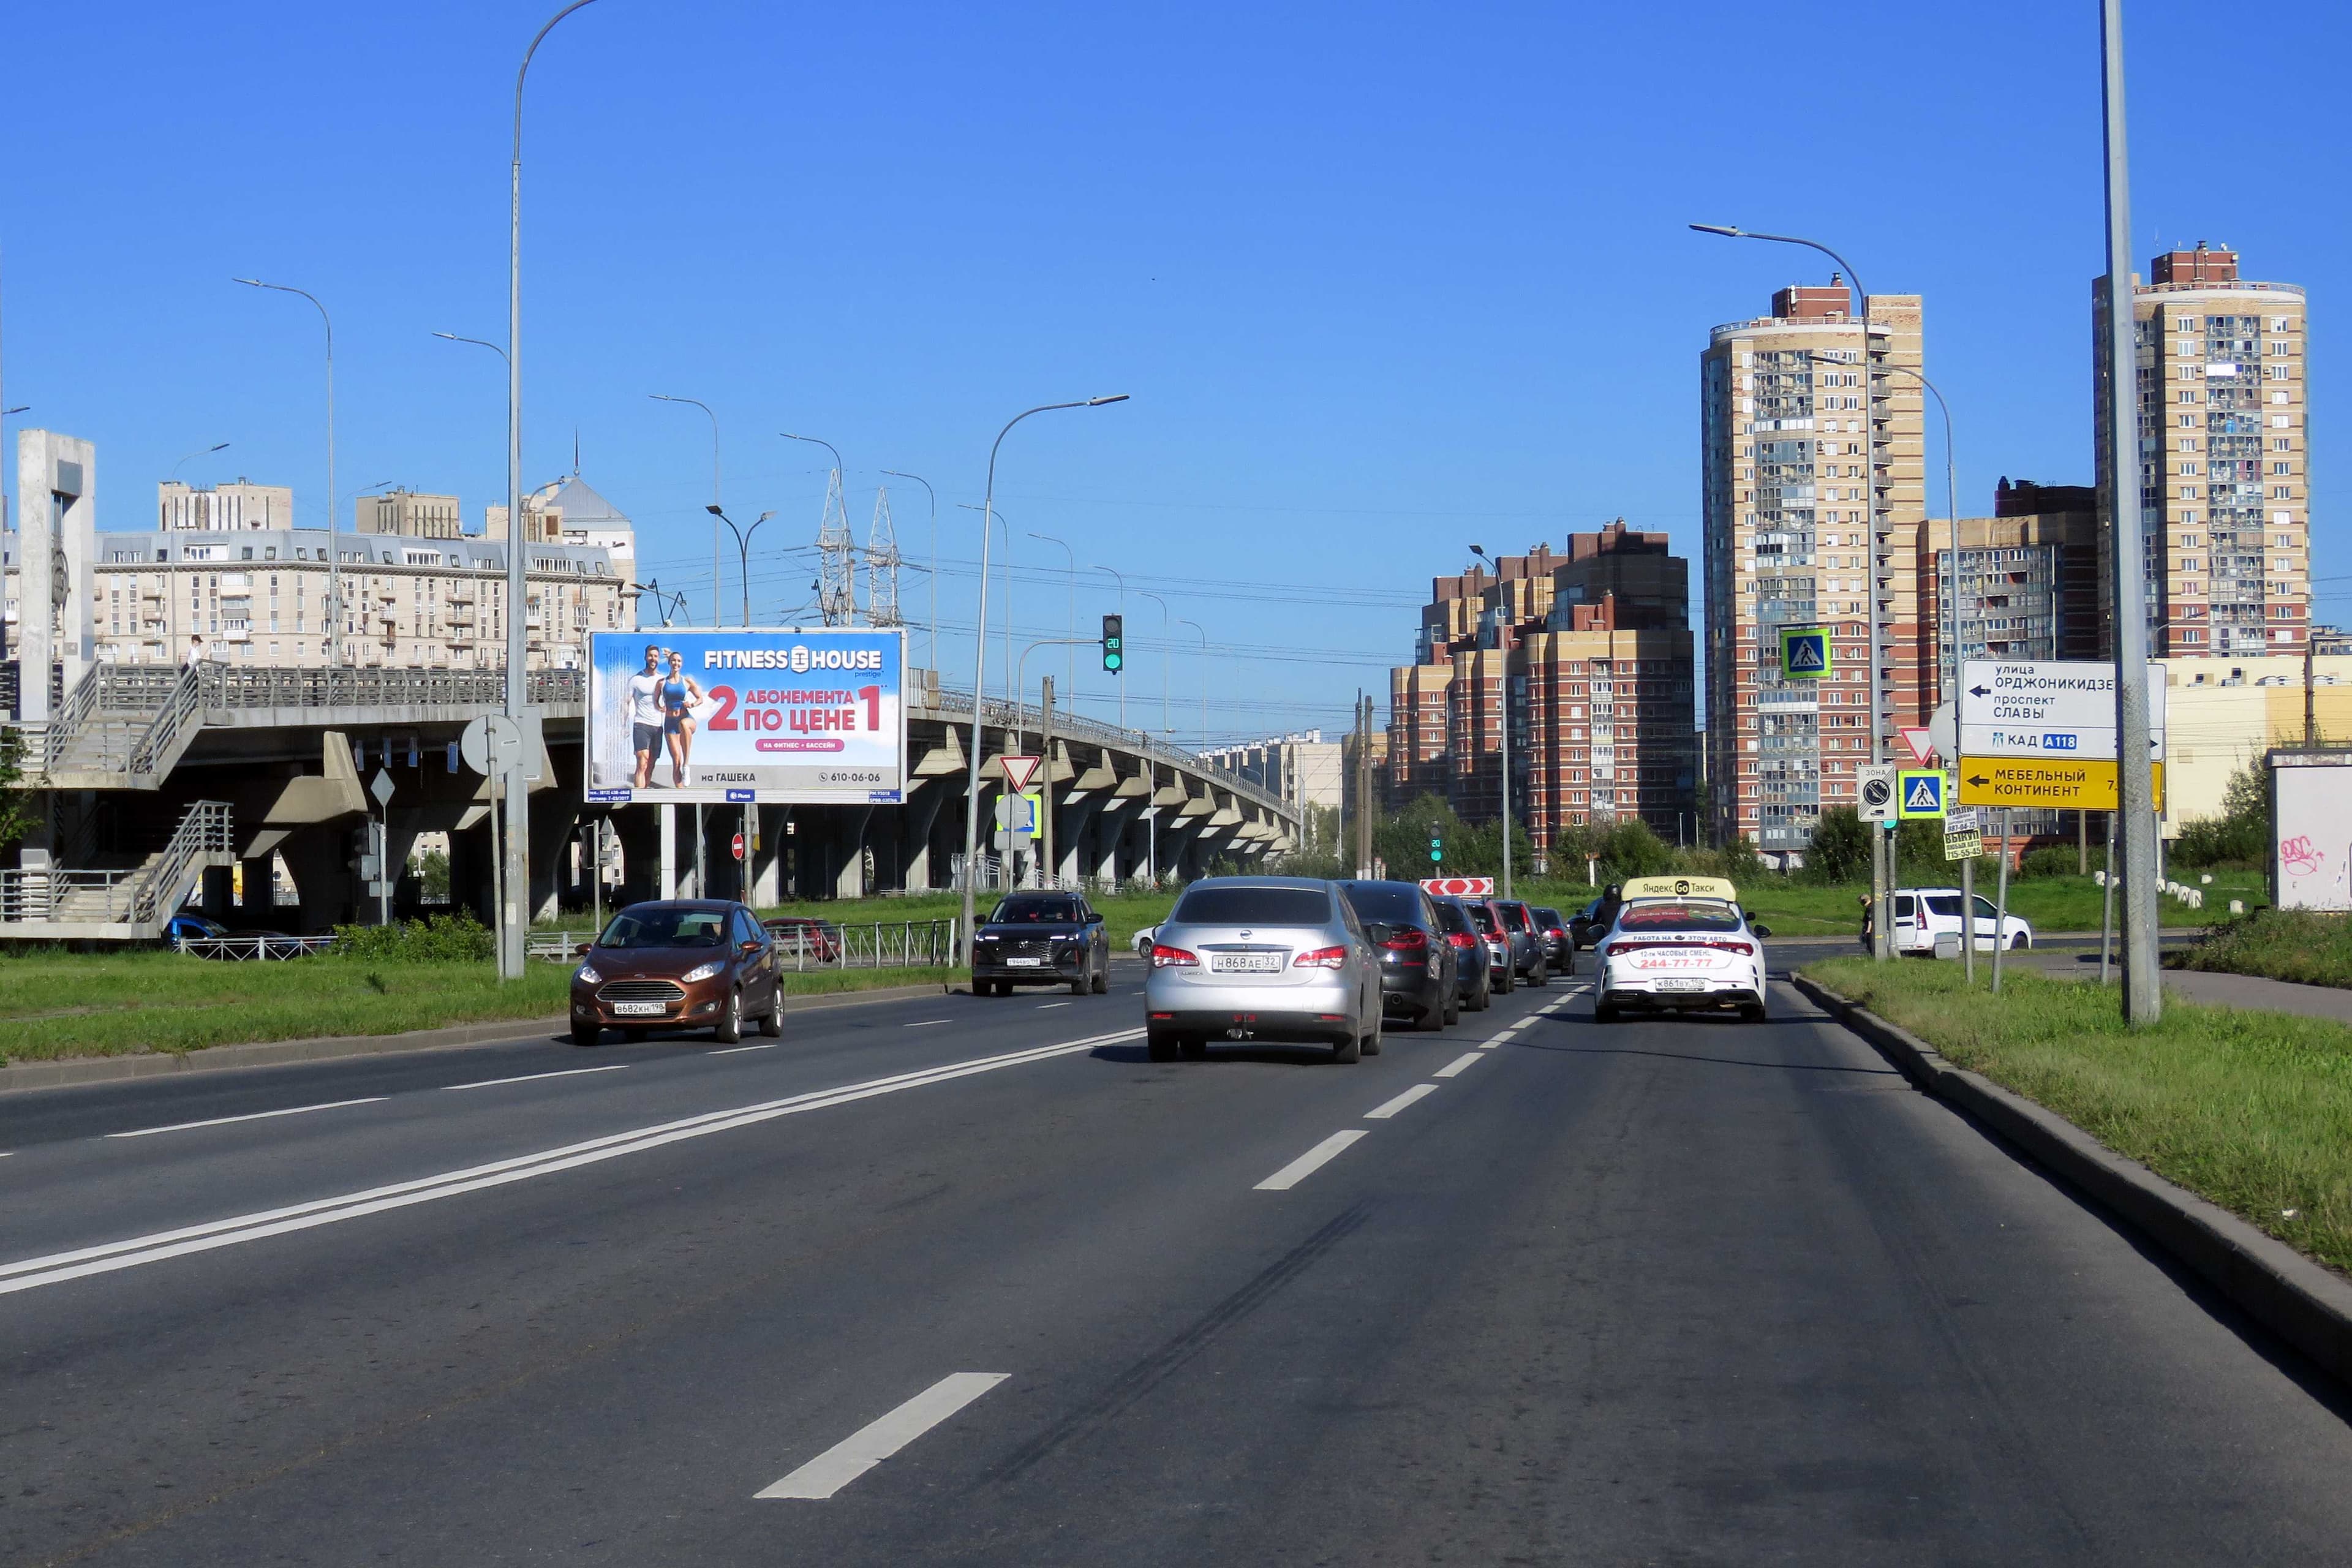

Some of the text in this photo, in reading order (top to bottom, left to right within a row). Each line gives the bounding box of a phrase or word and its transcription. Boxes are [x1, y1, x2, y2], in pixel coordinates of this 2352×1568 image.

[1107, 638, 1119, 648] 20
[704, 650, 881, 669] FITNESS HOUSE
[1996, 665, 2034, 675] улица
[1996, 677, 2114, 691] ОРДЖОНИКИДЗЕ
[1994, 696, 2056, 706] проспект
[707, 685, 854, 731] 2 АБОНЕМЕНТА
[744, 685, 880, 734] ПО ЦЕНЕ 1
[1994, 707, 2045, 718] СЛАВЫ
[2008, 735, 2038, 747] КАД
[716, 773, 756, 782] ГАШЕКА
[1995, 769, 2086, 782] МЕБЕЛЬНЫЙ
[1995, 785, 2080, 796] КОНТИНЕНТ
[1945, 830, 1979, 843] ВЫКУП
[1947, 847, 1981, 859] 715-55-45
[1643, 883, 1714, 892] Яндекс Go Такси
[1640, 959, 1713, 968] 244-77-77
